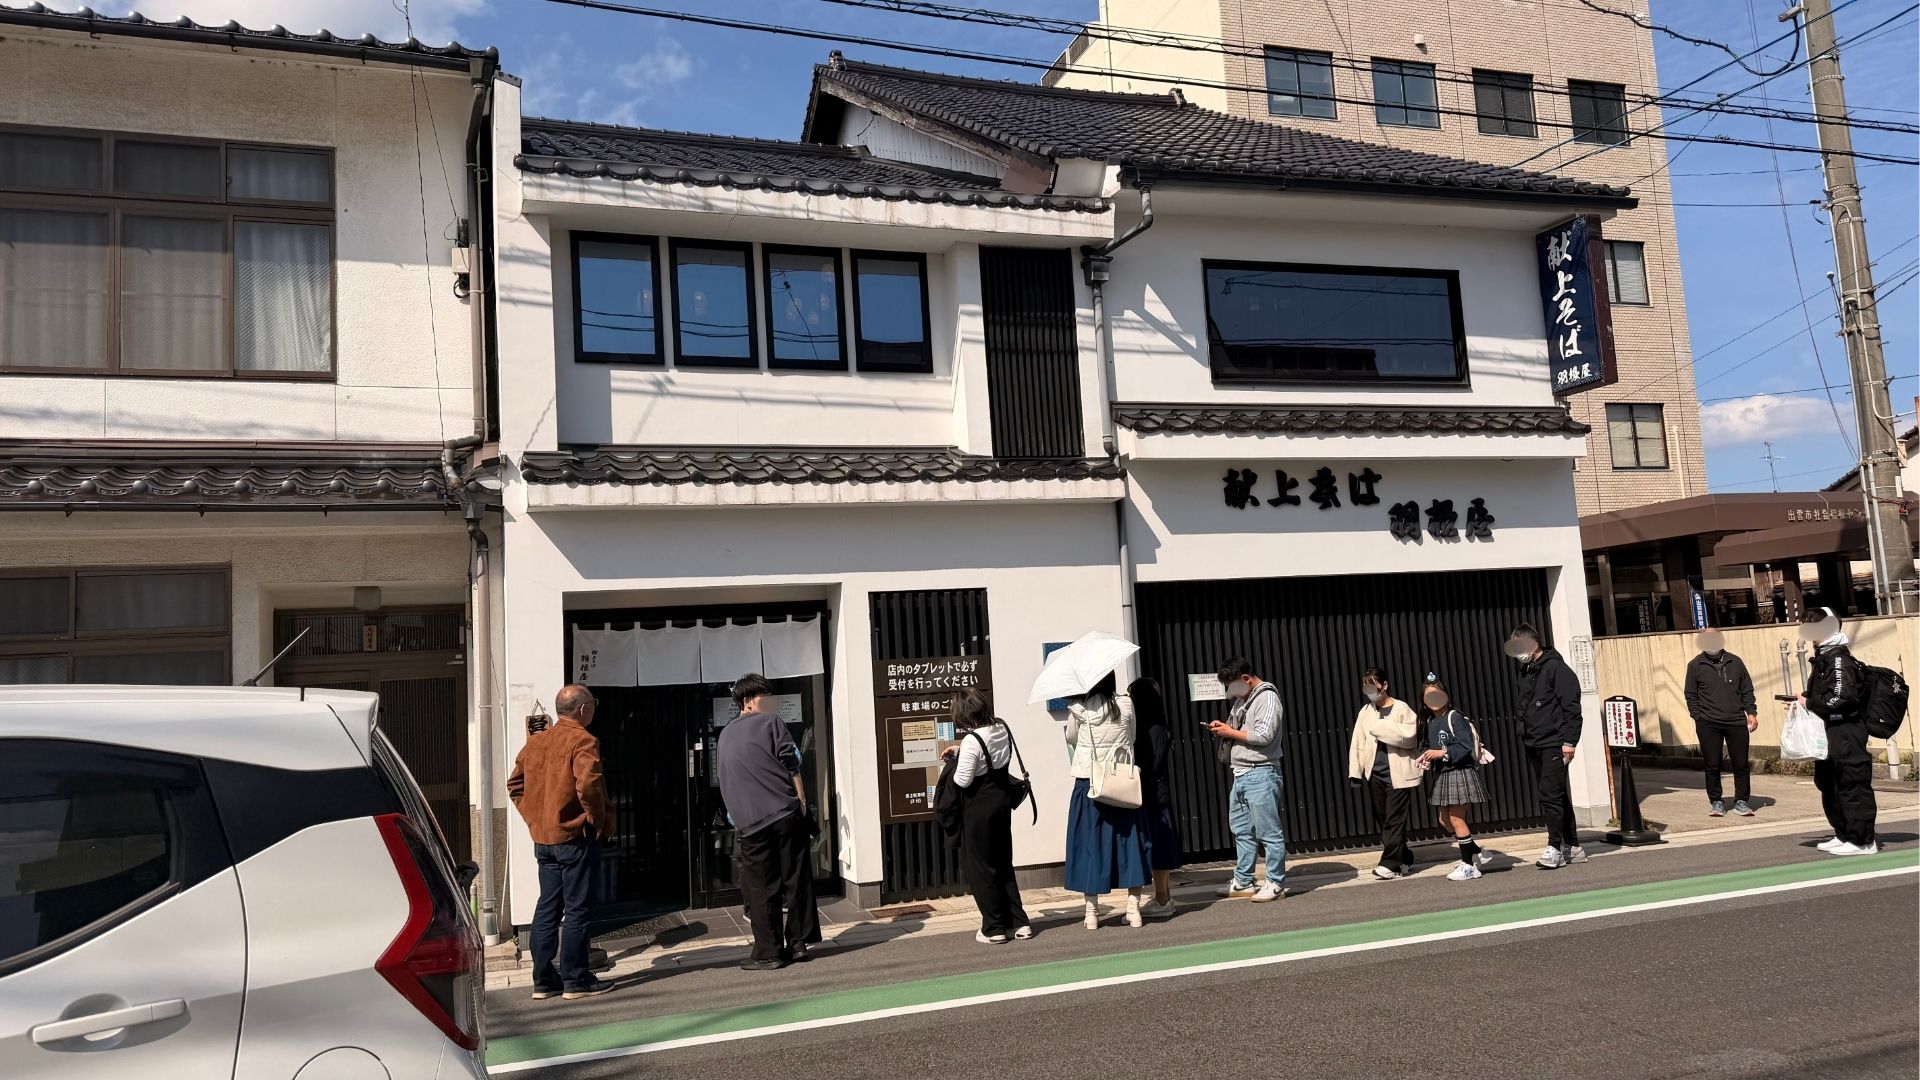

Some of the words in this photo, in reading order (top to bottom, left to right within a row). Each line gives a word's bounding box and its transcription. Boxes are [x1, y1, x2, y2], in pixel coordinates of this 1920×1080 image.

[1547, 231, 1583, 361] 献上そば
[887, 660, 978, 677] 店内のタブレットで必ず
[888, 675, 978, 691] 受付を行ってください
[901, 699, 953, 712] 駐車場のご
